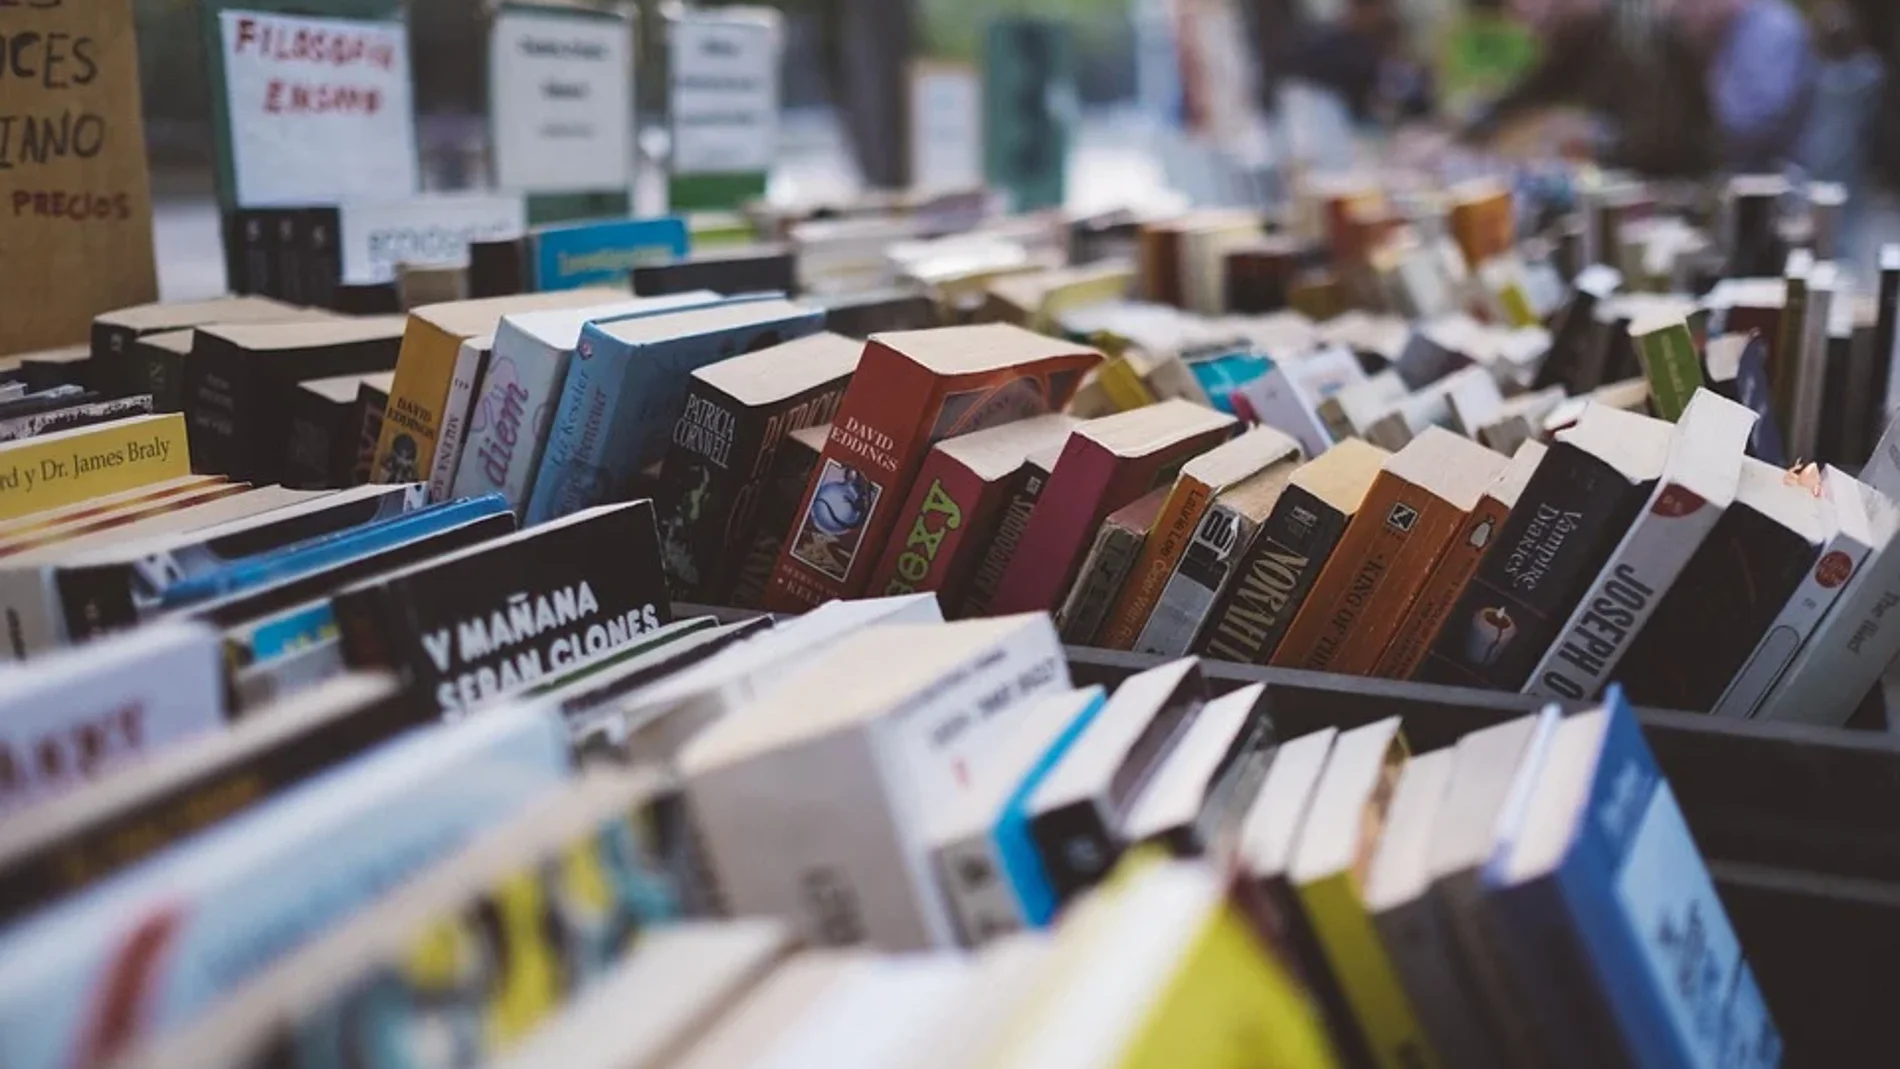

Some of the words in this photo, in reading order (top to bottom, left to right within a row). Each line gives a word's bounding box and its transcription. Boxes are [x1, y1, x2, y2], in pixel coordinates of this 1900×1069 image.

[0, 32, 97, 88] CES
[13, 190, 132, 221] PRECIOS
[562, 367, 590, 435] Kessler
[684, 393, 736, 444] PATRICIA
[477, 381, 530, 487] diem
[673, 418, 731, 470] CORNWELL
[831, 427, 898, 473] EDDINGS
[845, 417, 894, 451] DAVID
[24, 468, 36, 493] y
[40, 459, 69, 482] Dr.
[73, 448, 124, 480] James
[127, 435, 171, 467] Braly
[1180, 490, 1204, 530] Laurie
[1218, 536, 1309, 650] NORAH
[1346, 556, 1385, 608] KING
[458, 580, 599, 663] MAÑANA
[548, 603, 660, 671] CLONES
[1331, 606, 1353, 635] OF
[1557, 563, 1655, 678] JOSEPH
[1308, 634, 1340, 670] TH
